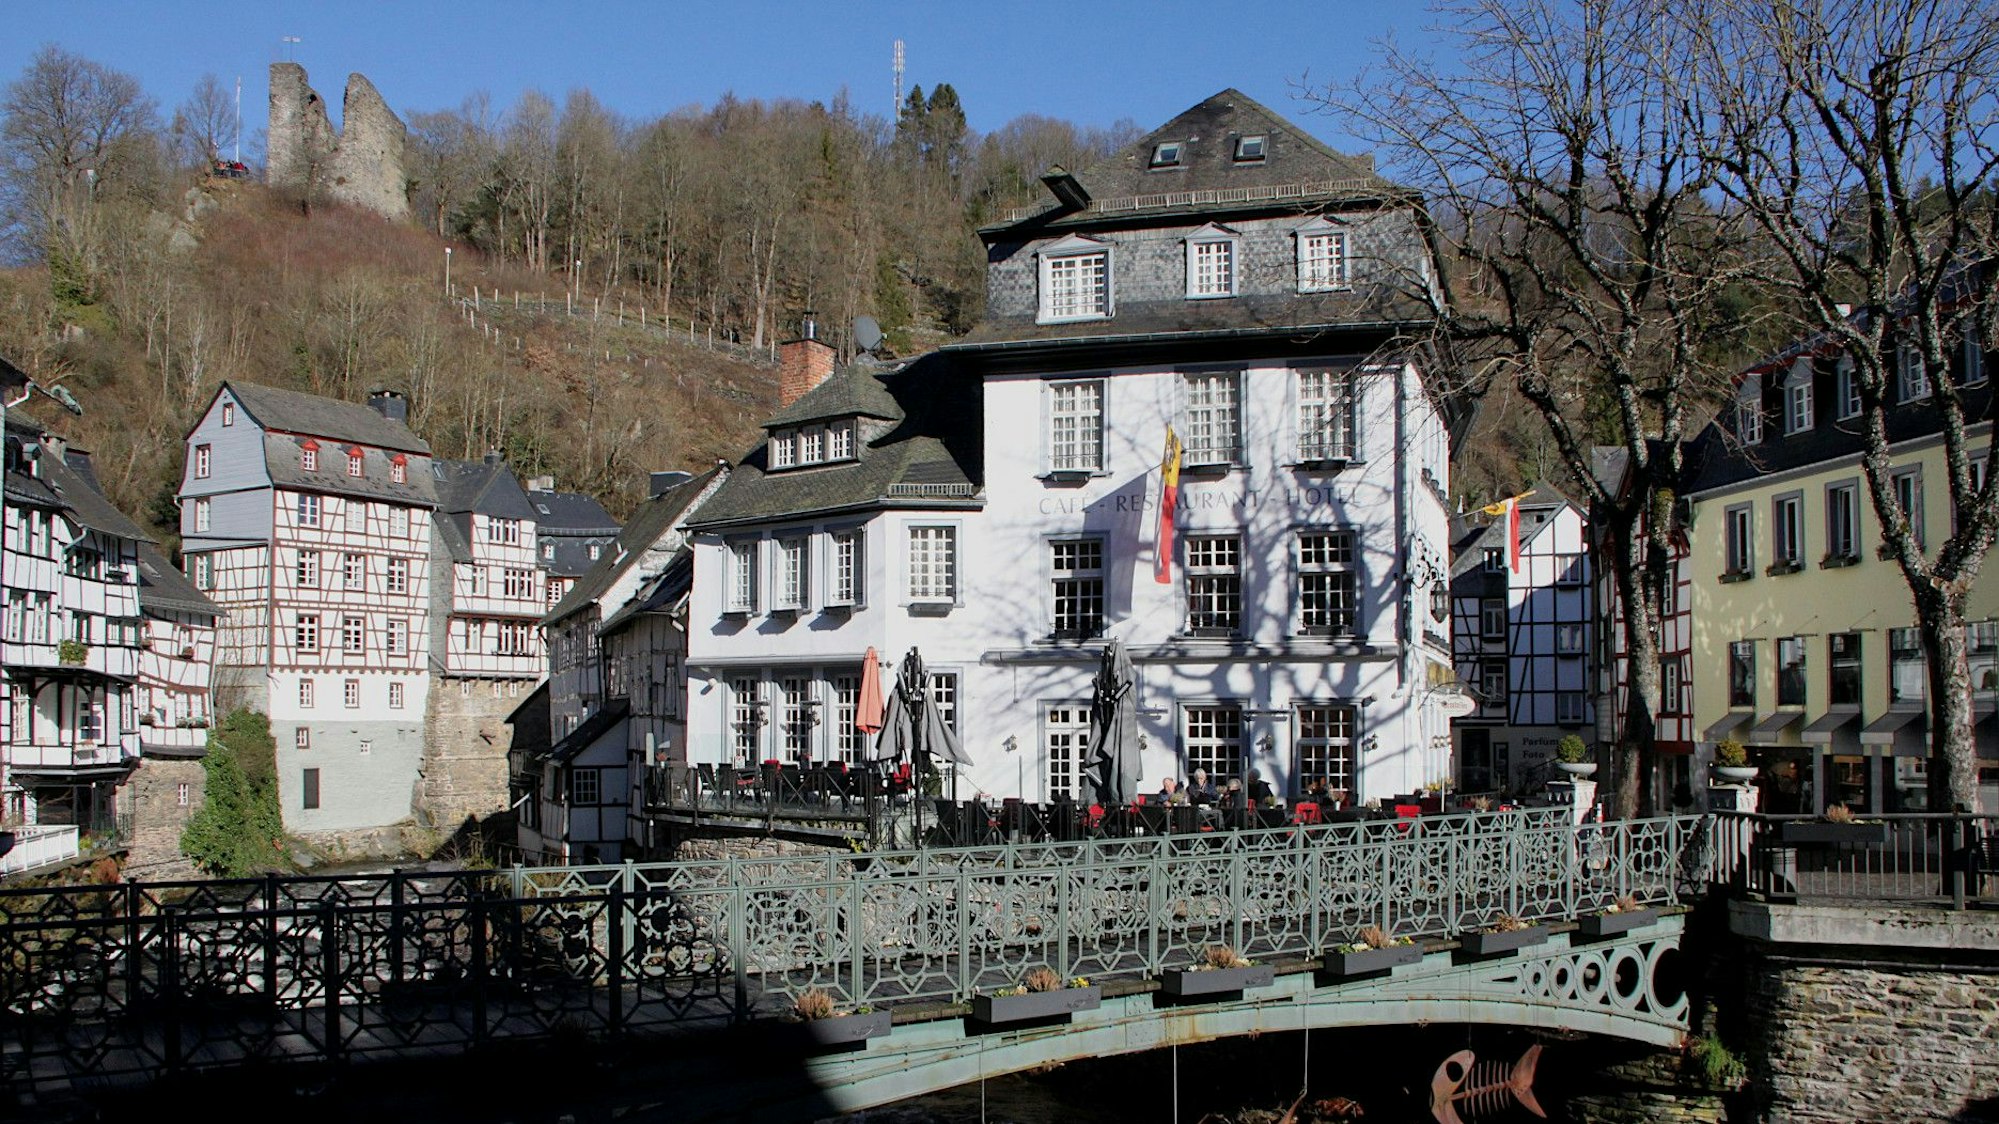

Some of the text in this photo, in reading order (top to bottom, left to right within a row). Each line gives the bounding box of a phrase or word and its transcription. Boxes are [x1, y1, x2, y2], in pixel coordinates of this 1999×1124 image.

[1116, 489, 1262, 512] RESAURANT
[1286, 486, 1361, 506] HOTEL
[1522, 750, 1545, 759] Foto
